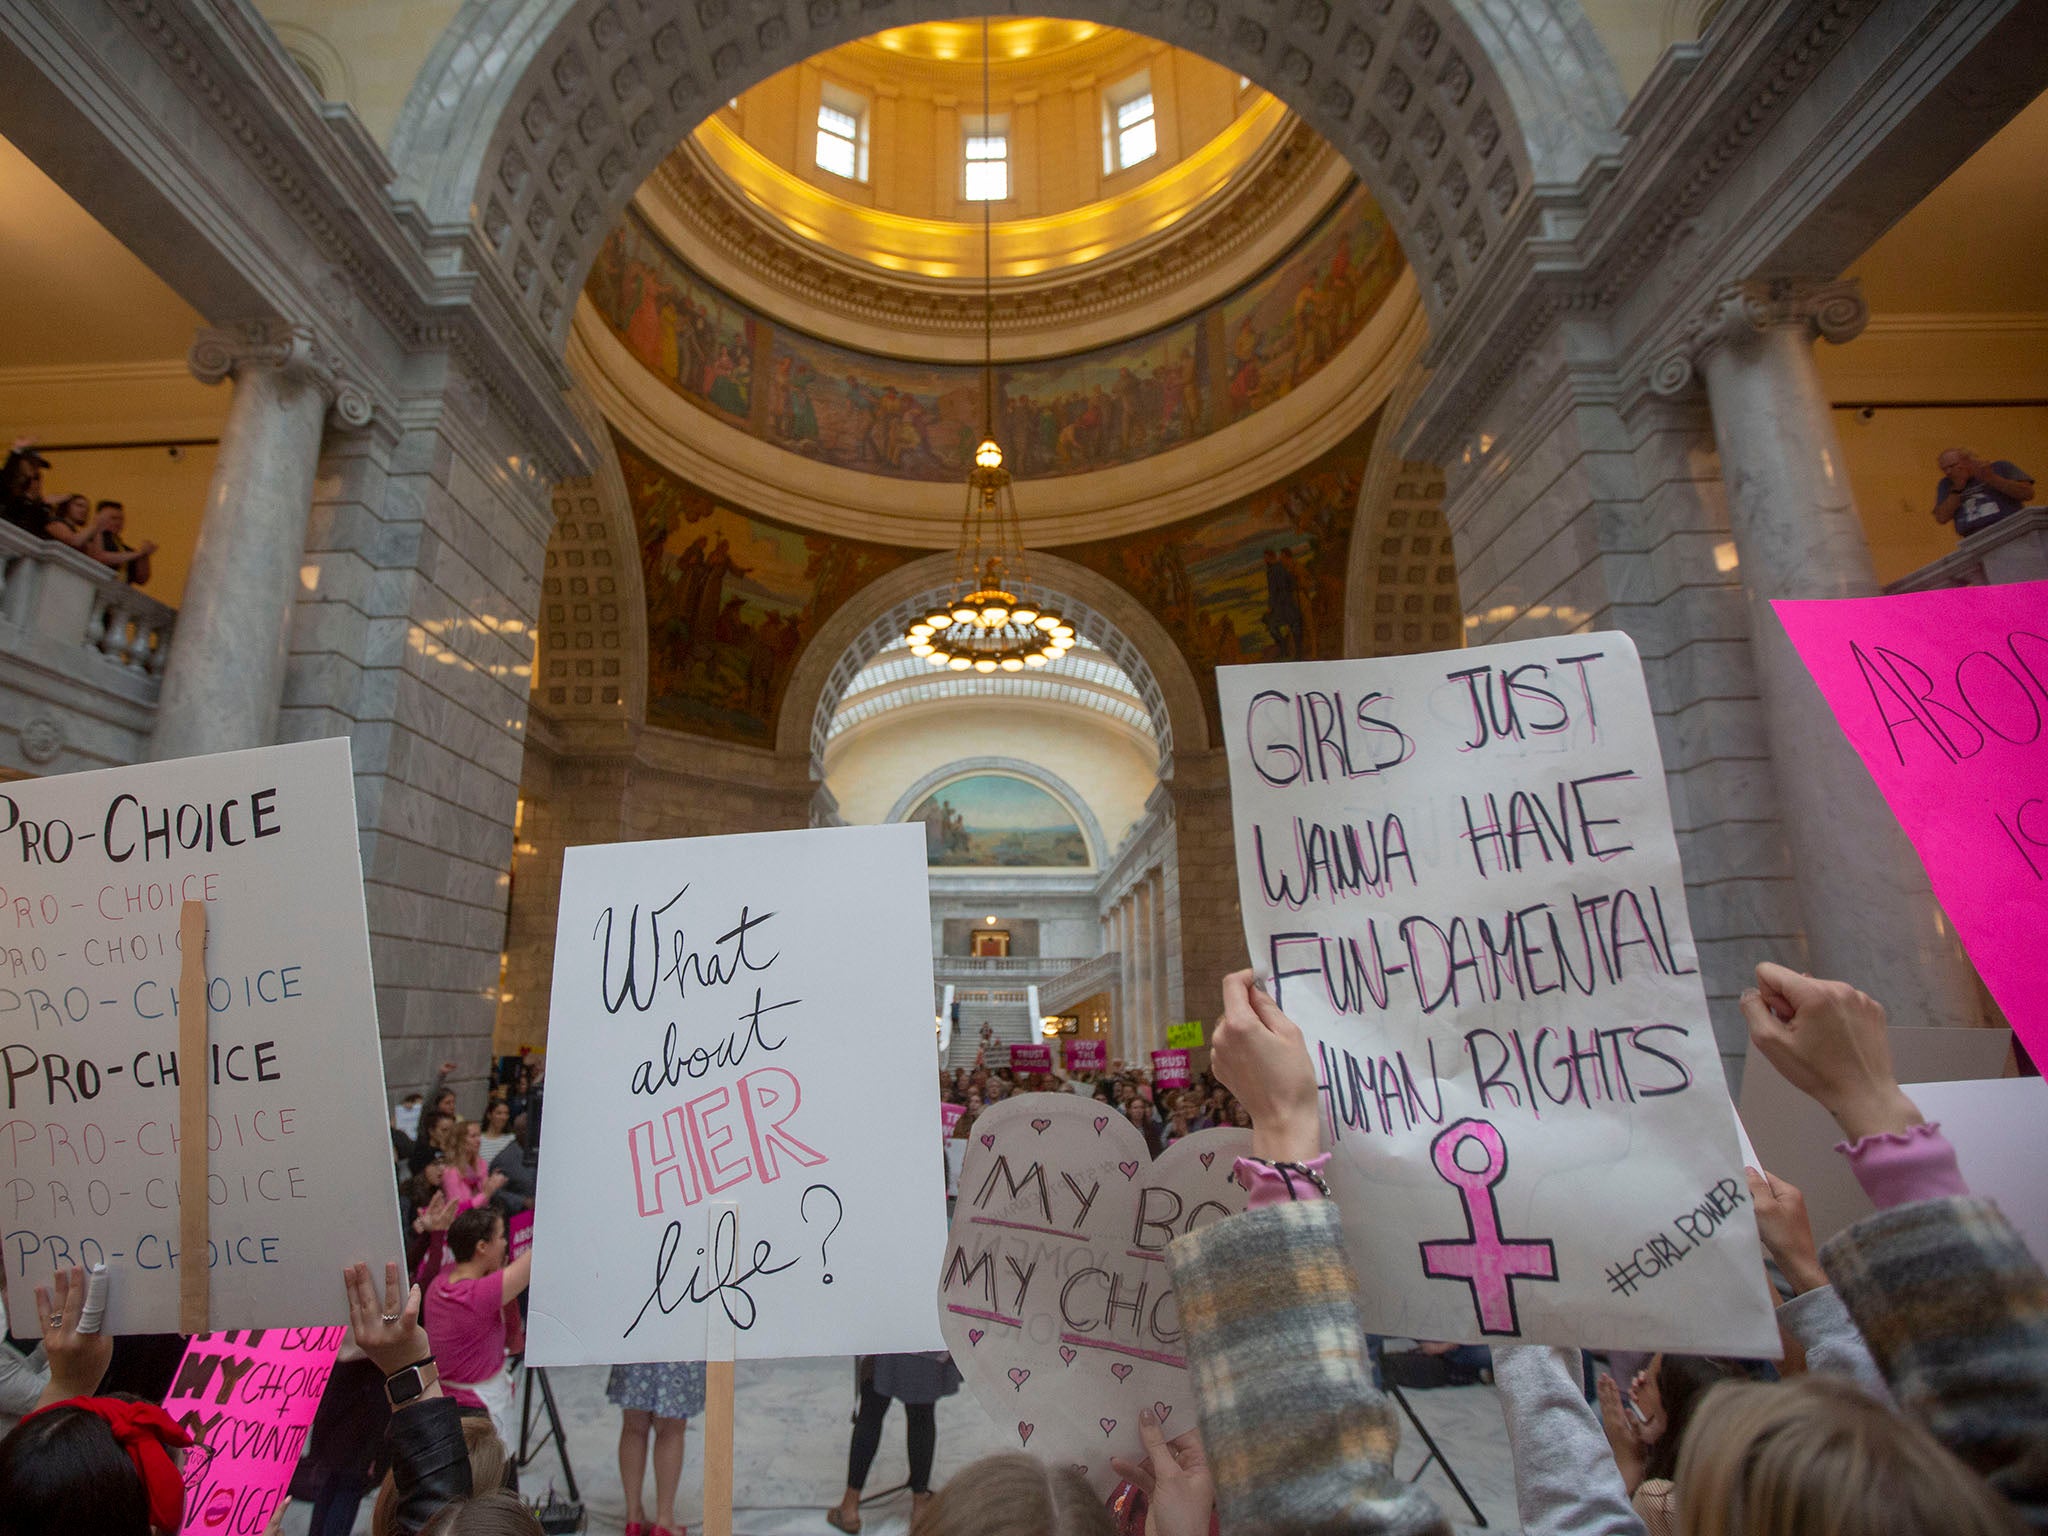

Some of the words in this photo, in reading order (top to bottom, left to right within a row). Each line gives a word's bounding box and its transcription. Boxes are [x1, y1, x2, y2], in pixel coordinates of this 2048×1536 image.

[1247, 690, 1416, 788] GIRLS
[1446, 653, 1604, 752] JUST
[1254, 813, 1418, 911] WANNA
[1460, 769, 1642, 878] HAVE
[0, 873, 220, 928] RO-CHOICE
[592, 883, 780, 1014] What
[1268, 886, 1698, 1014] FUN-DAMENTAL
[0, 1040, 281, 1110] PRO-CHICE
[631, 987, 802, 1095] about
[1154, 1055, 1187, 1069] TRUST
[1463, 1023, 1693, 1120] RIGHTS
[628, 1066, 829, 1218] HER
[5, 1167, 307, 1220] PRO-COICE
[972, 1154, 1100, 1230] MY
[943, 1245, 1037, 1316] MY
[170, 1351, 255, 1405] MY
